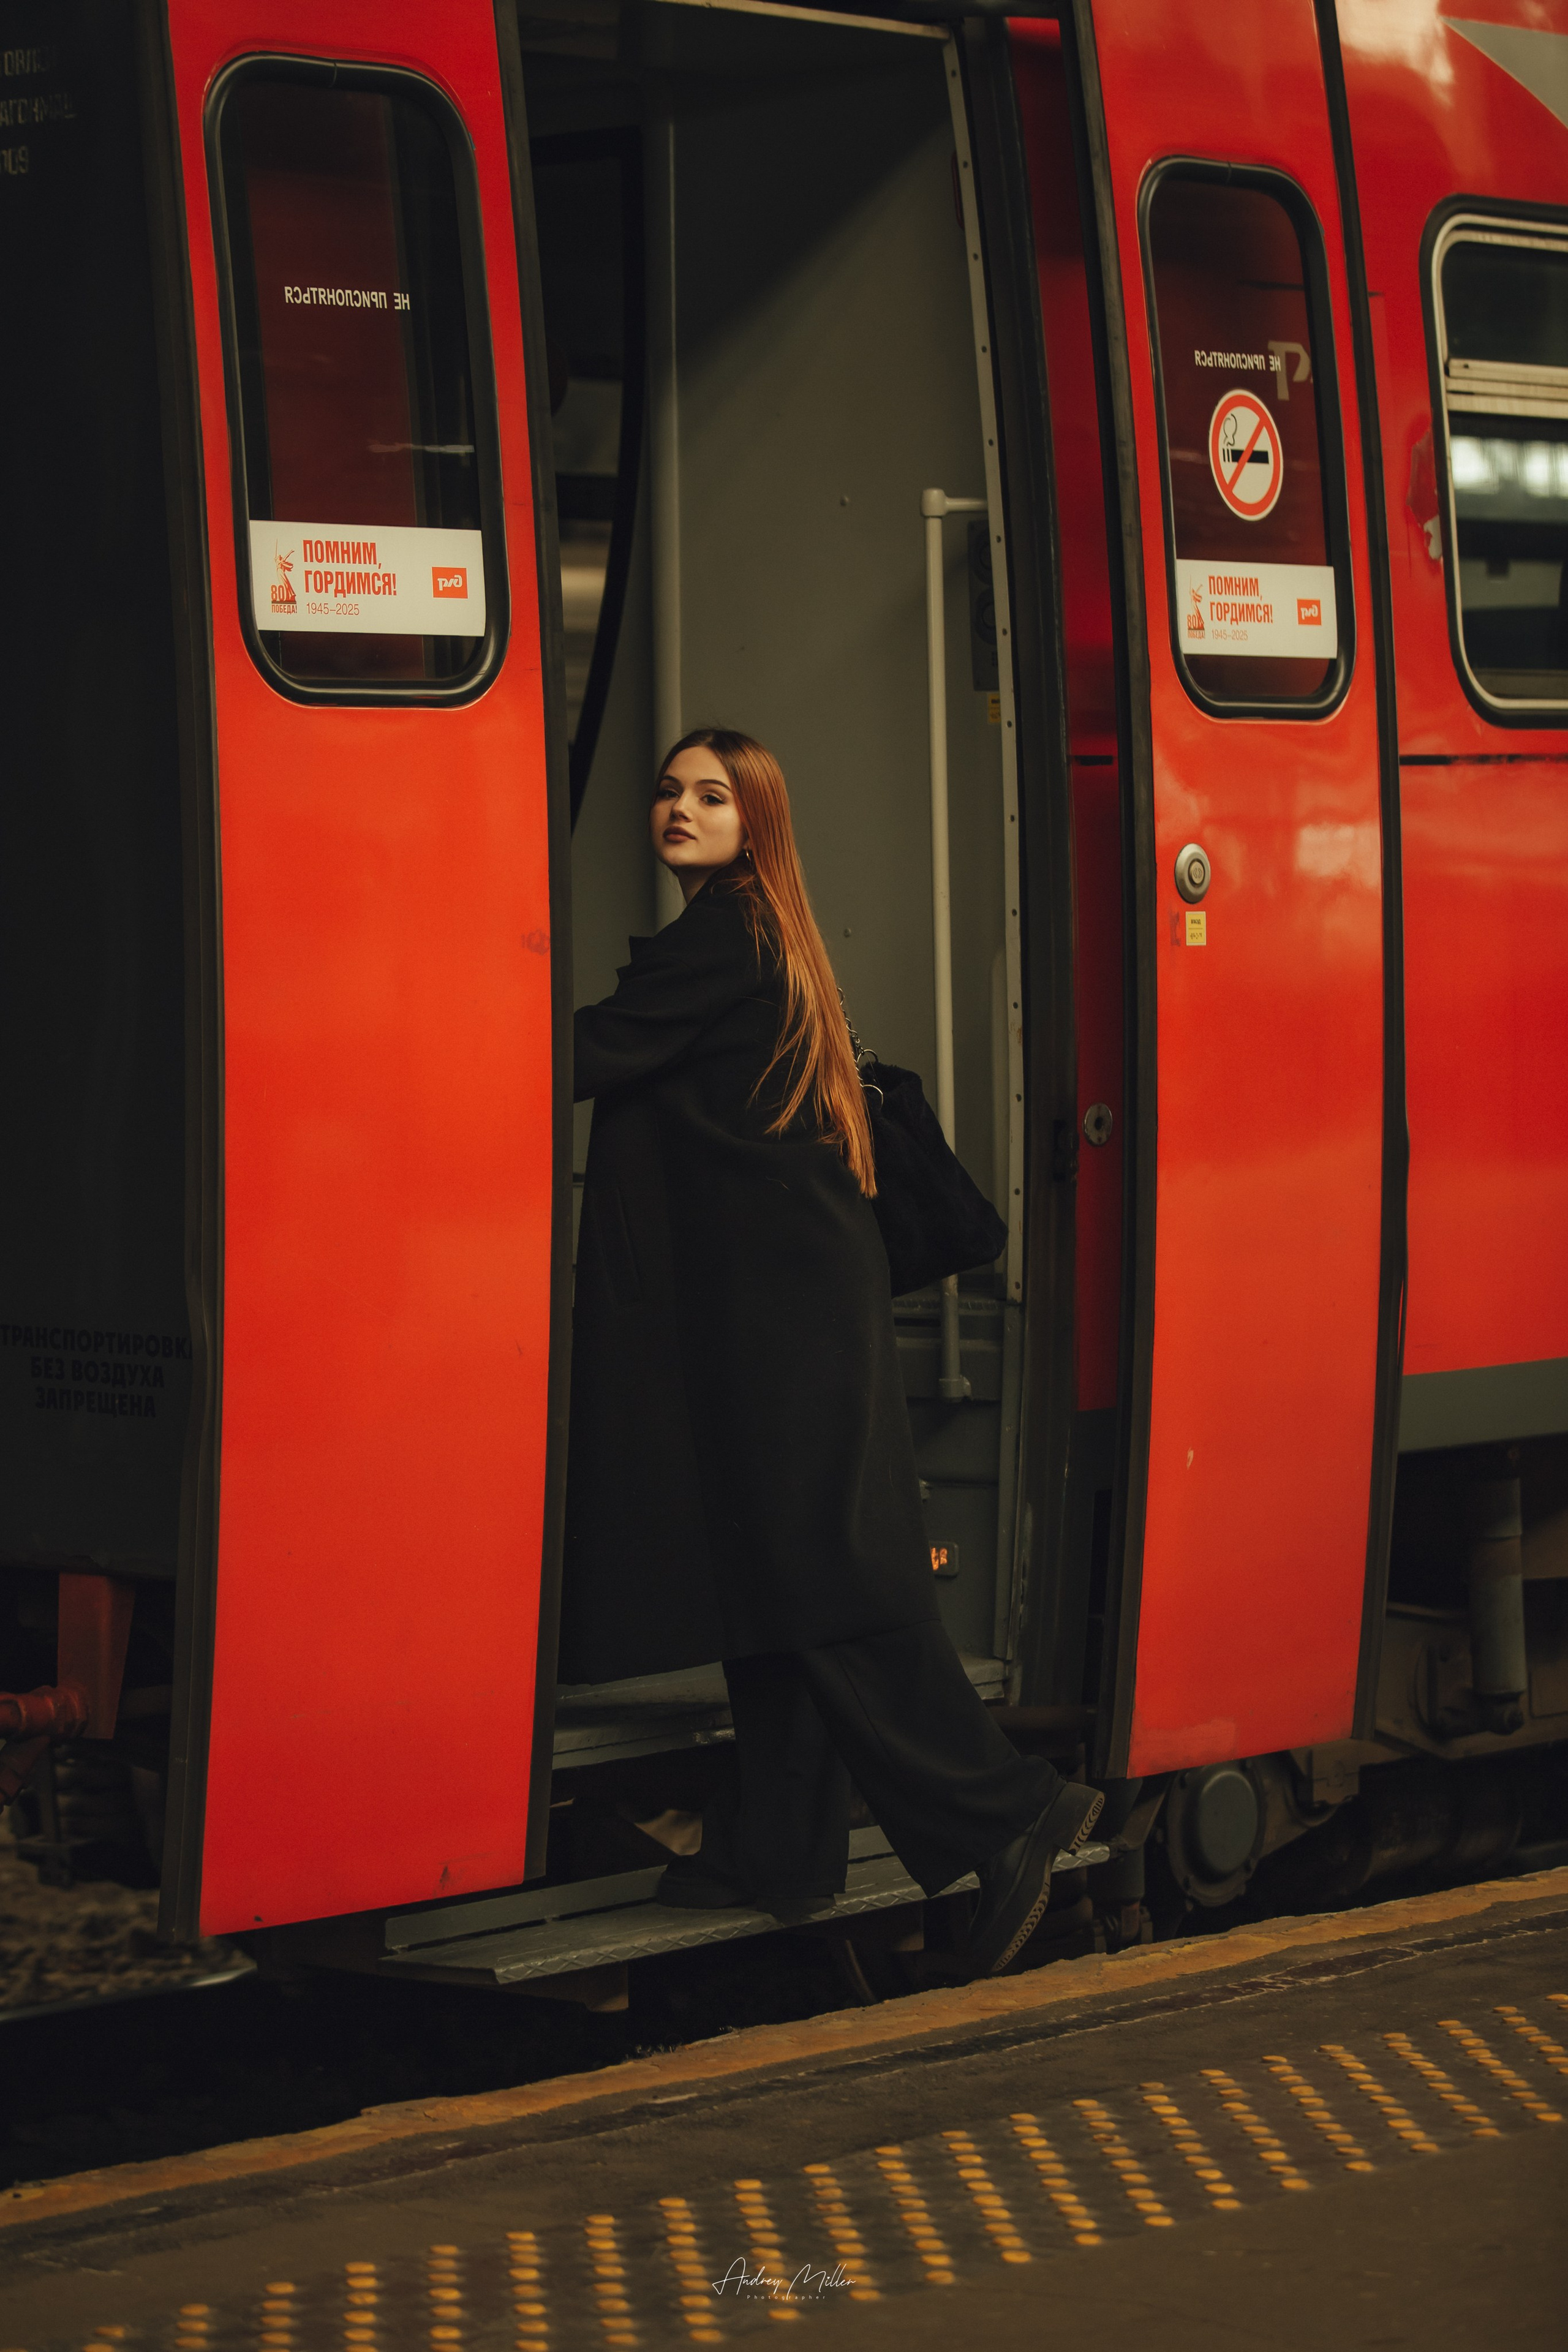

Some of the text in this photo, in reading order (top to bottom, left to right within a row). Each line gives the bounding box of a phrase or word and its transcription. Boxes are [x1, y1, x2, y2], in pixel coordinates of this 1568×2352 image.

[303, 539, 382, 569] ПОМНИМ,
[271, 584, 285, 601] 80
[305, 570, 397, 598] ГОРДИМСЯ!
[1208, 575, 1263, 600] ПОМНИМ,
[271, 605, 297, 614] ПОБЕДА!
[1210, 601, 1273, 625] ГОРДИМСЯ!
[31, 1356, 164, 1389] БЕЗ ВОЗДУХА
[35, 1386, 156, 1418] ЗАПРЕЩЕНА
